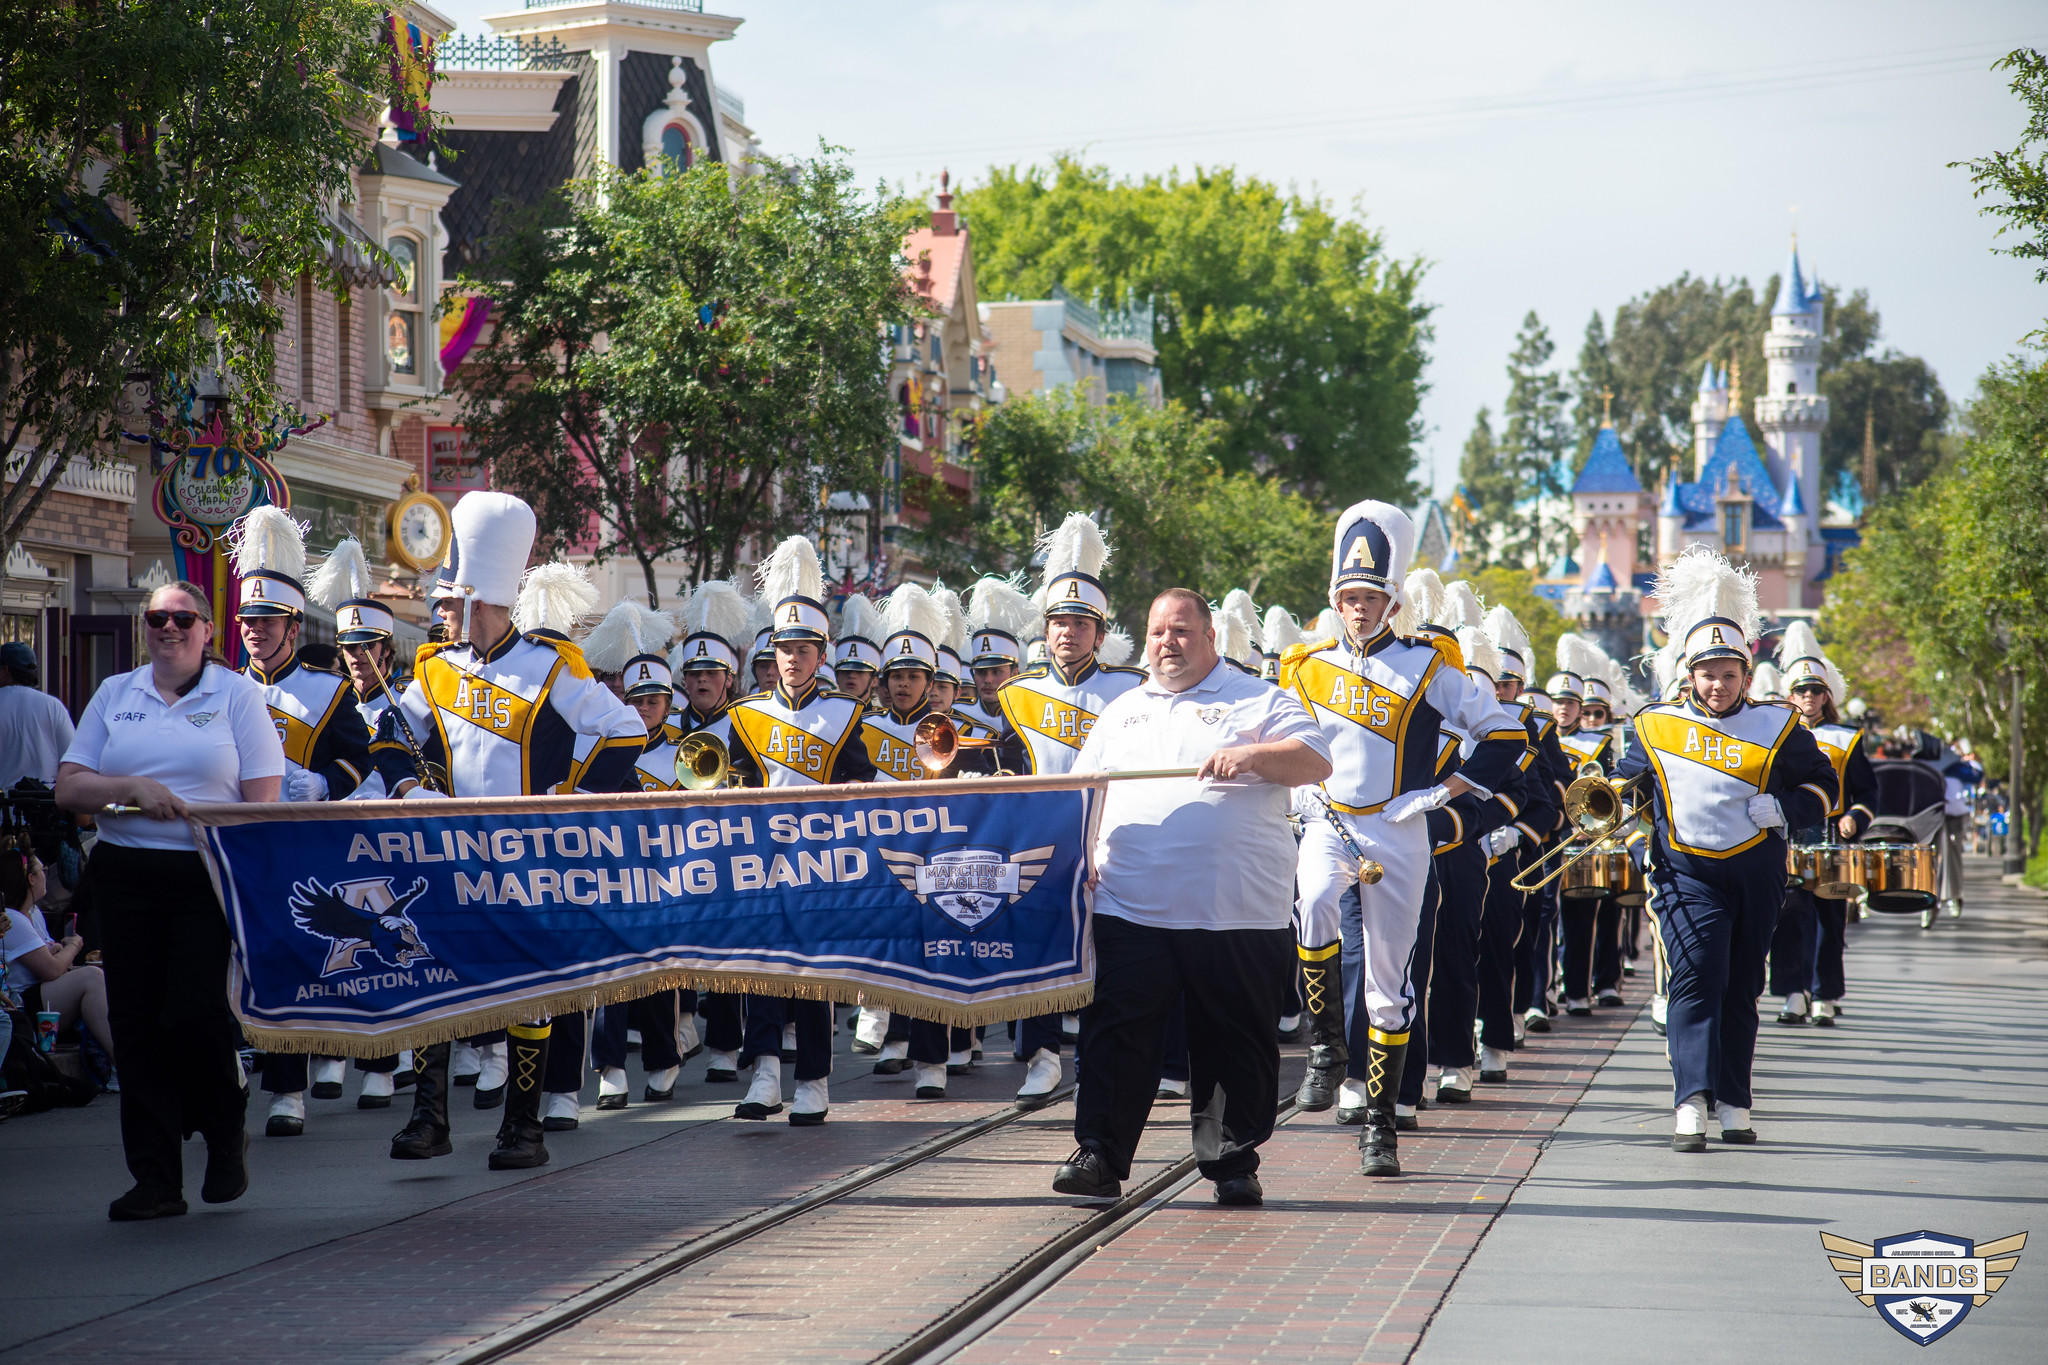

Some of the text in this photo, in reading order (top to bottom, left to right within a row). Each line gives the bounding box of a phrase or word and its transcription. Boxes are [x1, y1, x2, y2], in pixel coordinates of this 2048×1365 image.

[187, 444, 243, 480] 70
[198, 496, 230, 507] HAPPY
[1342, 536, 1375, 570] A
[251, 579, 264, 598] A
[1066, 581, 1080, 599] A
[350, 608, 363, 626] A
[787, 605, 800, 623] A
[981, 637, 992, 652] A
[1711, 626, 1725, 645] A
[696, 641, 708, 656] A
[848, 644, 858, 657] A
[900, 638, 913, 654] A
[639, 663, 651, 680] A
[1267, 661, 1276, 675] A
[1803, 662, 1812, 675] A
[1562, 676, 1570, 688] A
[1587, 684, 1595, 695] A
[454, 678, 511, 729] AHS
[1329, 675, 1390, 727] AHS
[114, 712, 146, 722] STAFF
[767, 725, 822, 772] AHS
[1683, 726, 1742, 769] AHS
[347, 807, 968, 863] ARLINGTON HIGH SCHOOL
[454, 847, 869, 907] MARCHING BAND
[925, 864, 1006, 879] MARCHING
[935, 877, 997, 891] EAGLES
[924, 940, 1014, 959] EST. 1925
[295, 967, 458, 1001] ARLINGTON, WA
